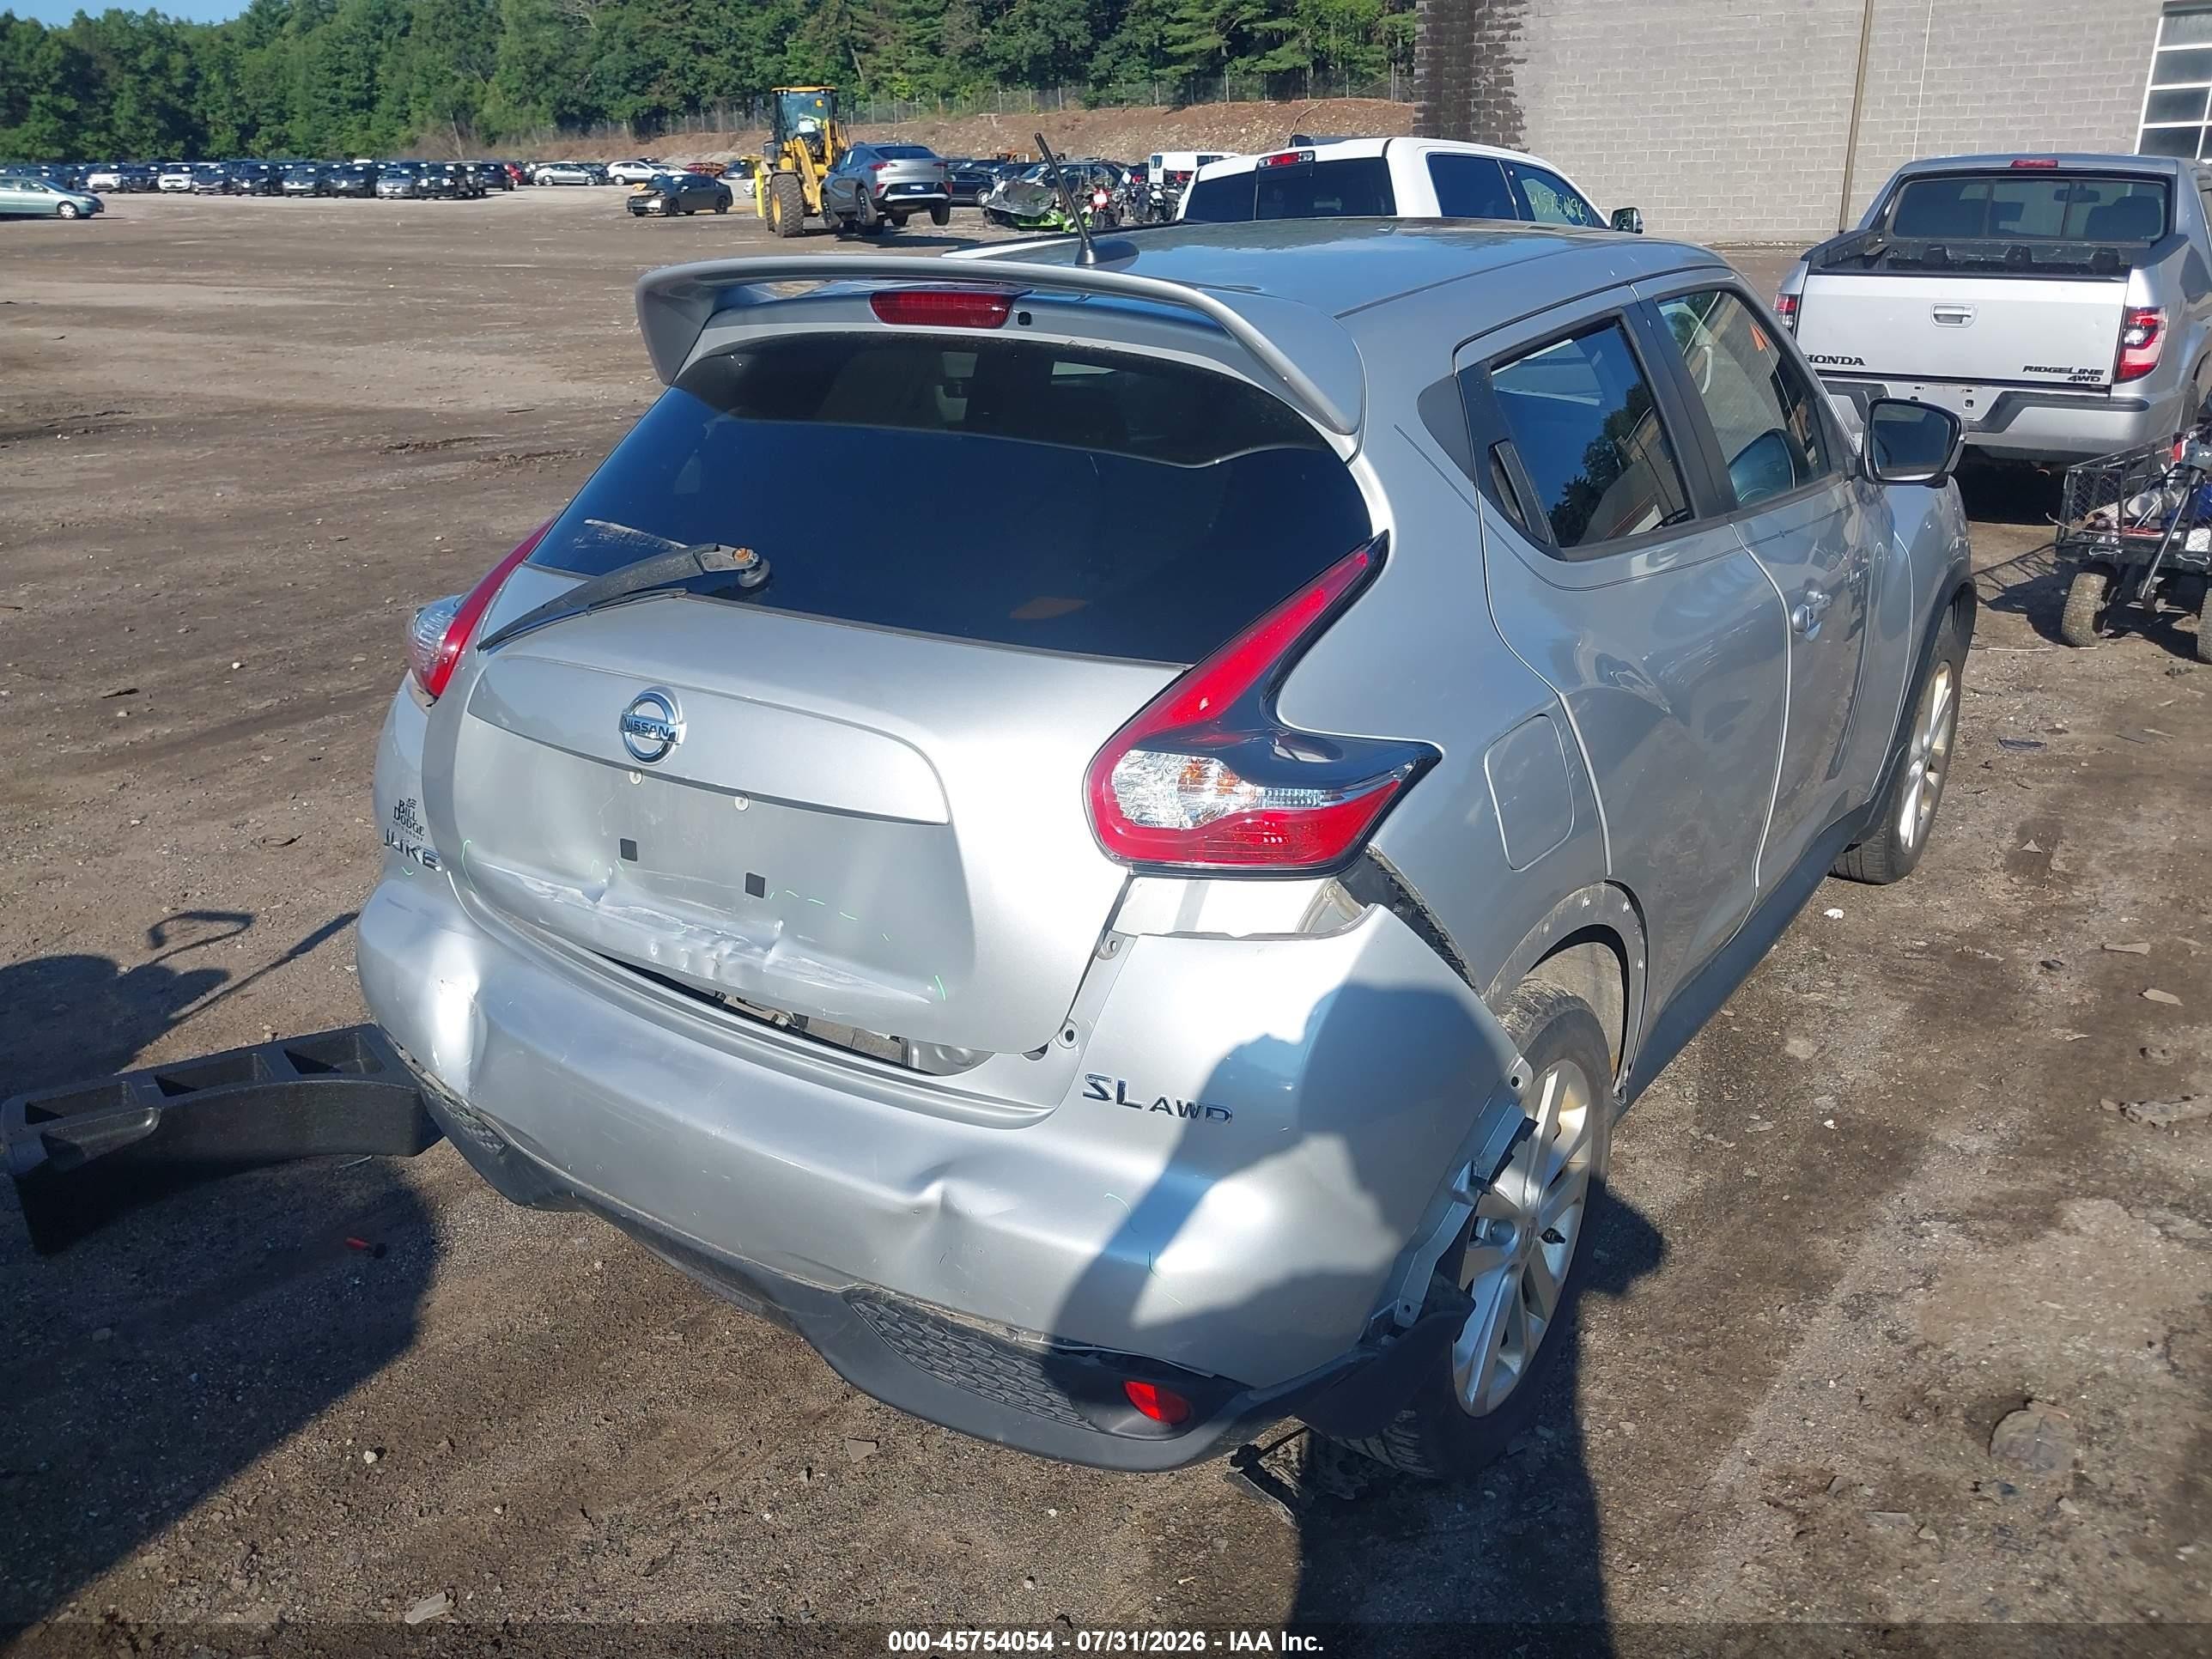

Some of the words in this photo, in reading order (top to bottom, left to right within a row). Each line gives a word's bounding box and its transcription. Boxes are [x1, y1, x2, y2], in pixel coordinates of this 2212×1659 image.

[1804, 354, 1866, 366] HONDA
[2022, 365, 2106, 376] RIDGELINE
[2067, 374, 2101, 383] 4WD
[623, 718, 670, 738] NISSAN
[393, 805, 425, 837] DODGE
[398, 798, 417, 823] BILL
[383, 828, 441, 872] JUKE
[1082, 1073, 1145, 1110] SL
[1148, 1095, 1234, 1124] AWD
